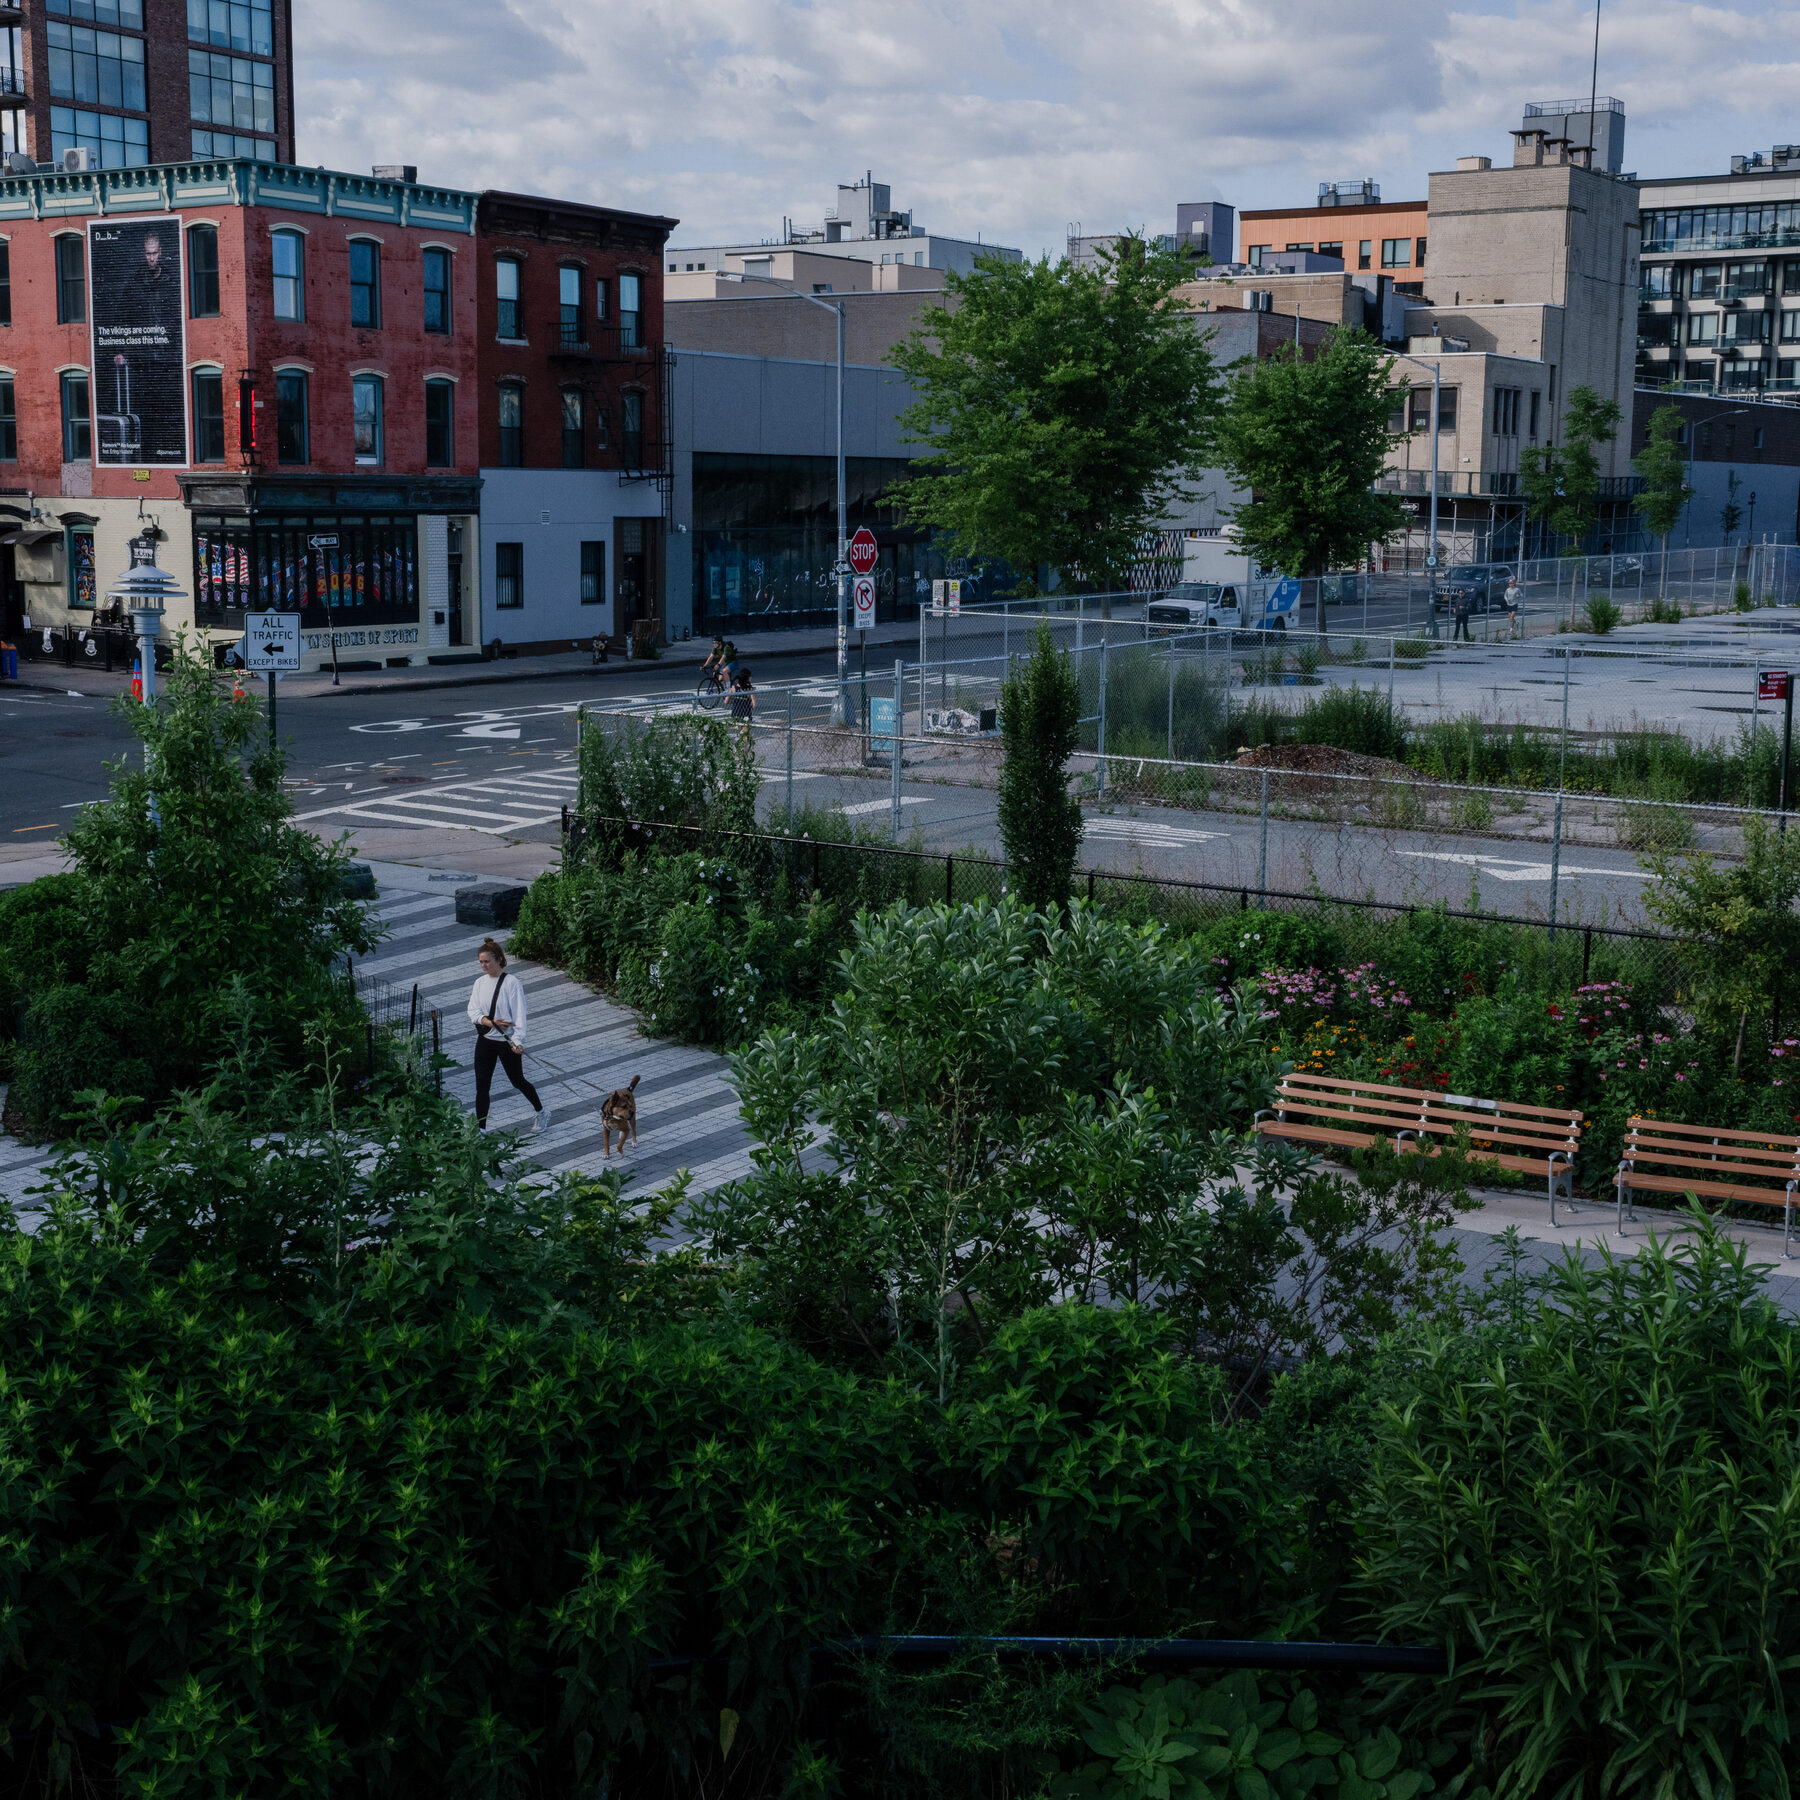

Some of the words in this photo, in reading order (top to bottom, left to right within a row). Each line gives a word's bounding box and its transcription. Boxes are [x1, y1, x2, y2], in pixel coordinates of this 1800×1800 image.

[99, 327, 110, 335] The
[111, 326, 131, 336] vikings
[143, 325, 167, 335] coming.
[99, 337, 125, 345] Business
[126, 336, 141, 344] class
[142, 336, 153, 344] this
[154, 336, 170, 344] time.
[853, 543, 875, 560] STOP
[262, 617, 284, 628] ALL
[253, 631, 293, 640] TRAFFIC
[334, 631, 366, 647] HOME
[368, 631, 381, 645] OF
[384, 629, 419, 644] SPORT
[248, 658, 275, 666] EXCEPT
[277, 658, 298, 666] BIKES
